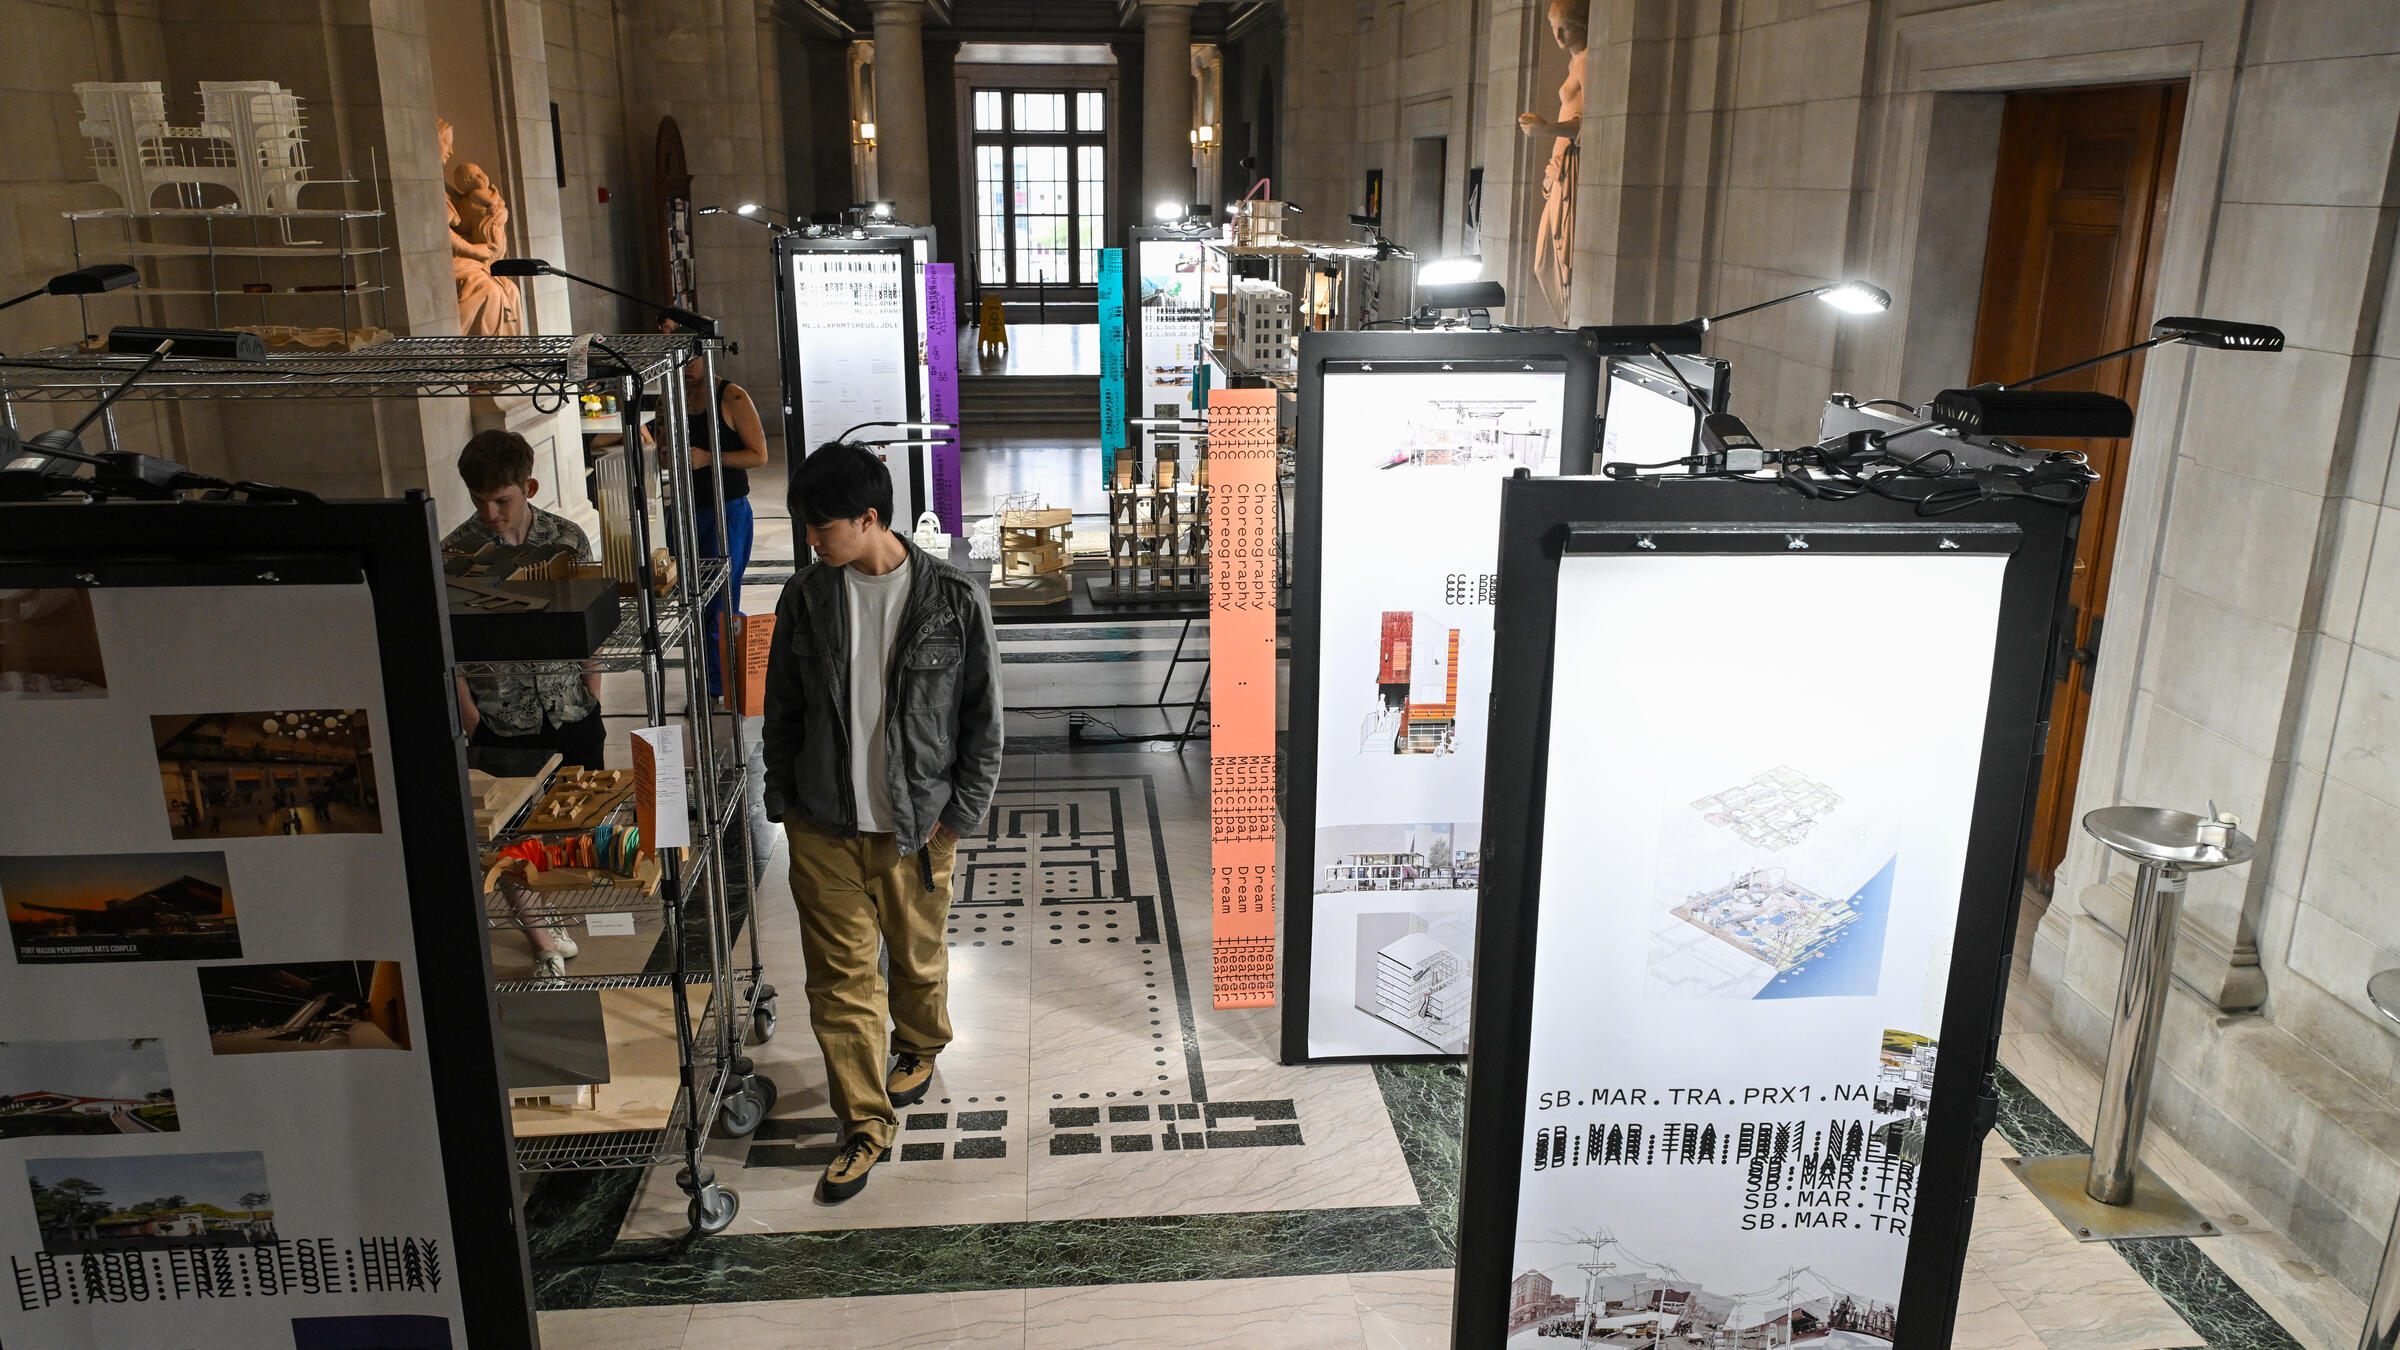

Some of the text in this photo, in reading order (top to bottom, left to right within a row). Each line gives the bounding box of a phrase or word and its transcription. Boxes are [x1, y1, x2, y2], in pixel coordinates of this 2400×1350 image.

[1218, 485, 1232, 611] Choreography
[1235, 484, 1249, 611] Choreography
[1252, 483, 1266, 610] Choreography
[1212, 757, 1226, 844] Municipal
[1224, 757, 1237, 843] Municipal
[1235, 756, 1248, 843] Municipal
[1246, 756, 1260, 842] Municipal
[1258, 756, 1271, 842] Municipal
[1222, 867, 1232, 913] Dream
[1239, 867, 1248, 913] Dream
[1255, 866, 1265, 912] Dream
[1741, 1211, 1911, 1237] SB.MAR.TR
[1743, 1191, 1914, 1217] SB.MAR.TR
